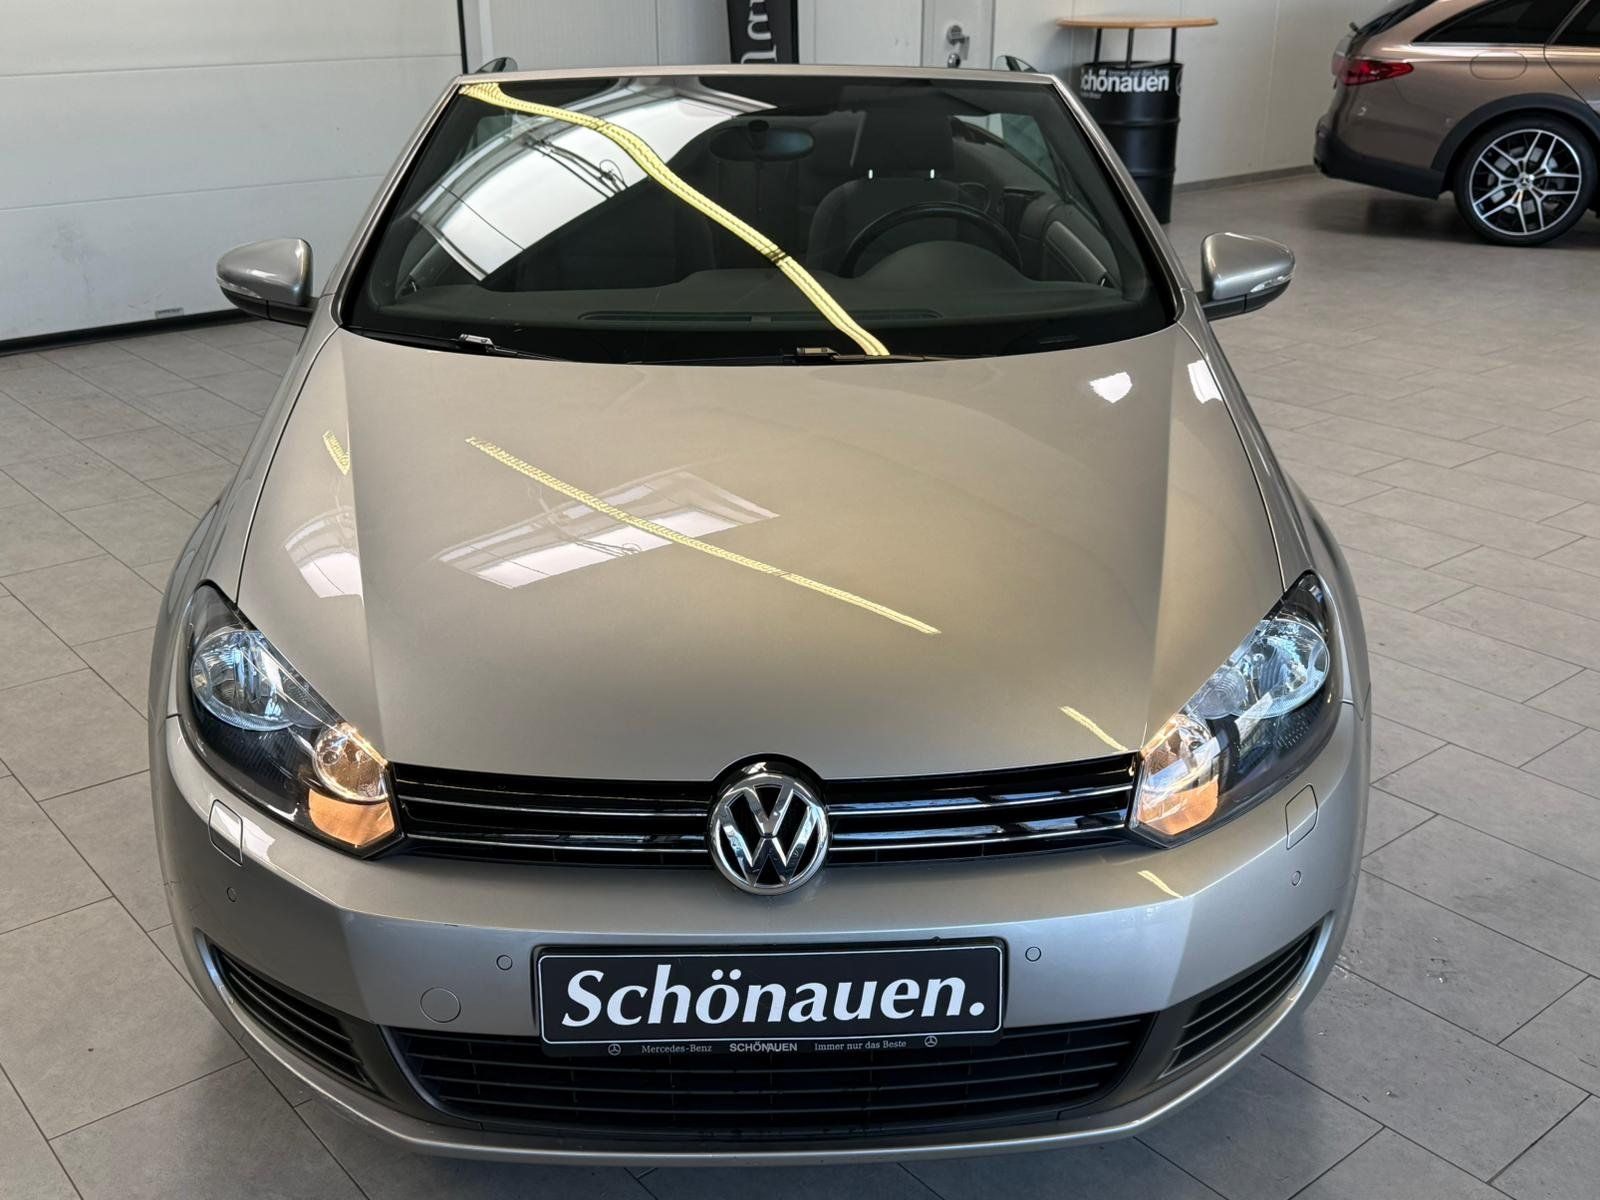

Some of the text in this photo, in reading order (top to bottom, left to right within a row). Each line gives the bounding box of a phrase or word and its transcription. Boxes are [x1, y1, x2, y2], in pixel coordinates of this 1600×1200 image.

[1081, 69, 1169, 92] chönauen
[562, 965, 985, 1027] Schönauen.
[641, 1039, 907, 1054] Mercedes-Benz SCHÖNAUEN Immer nur das Beste
